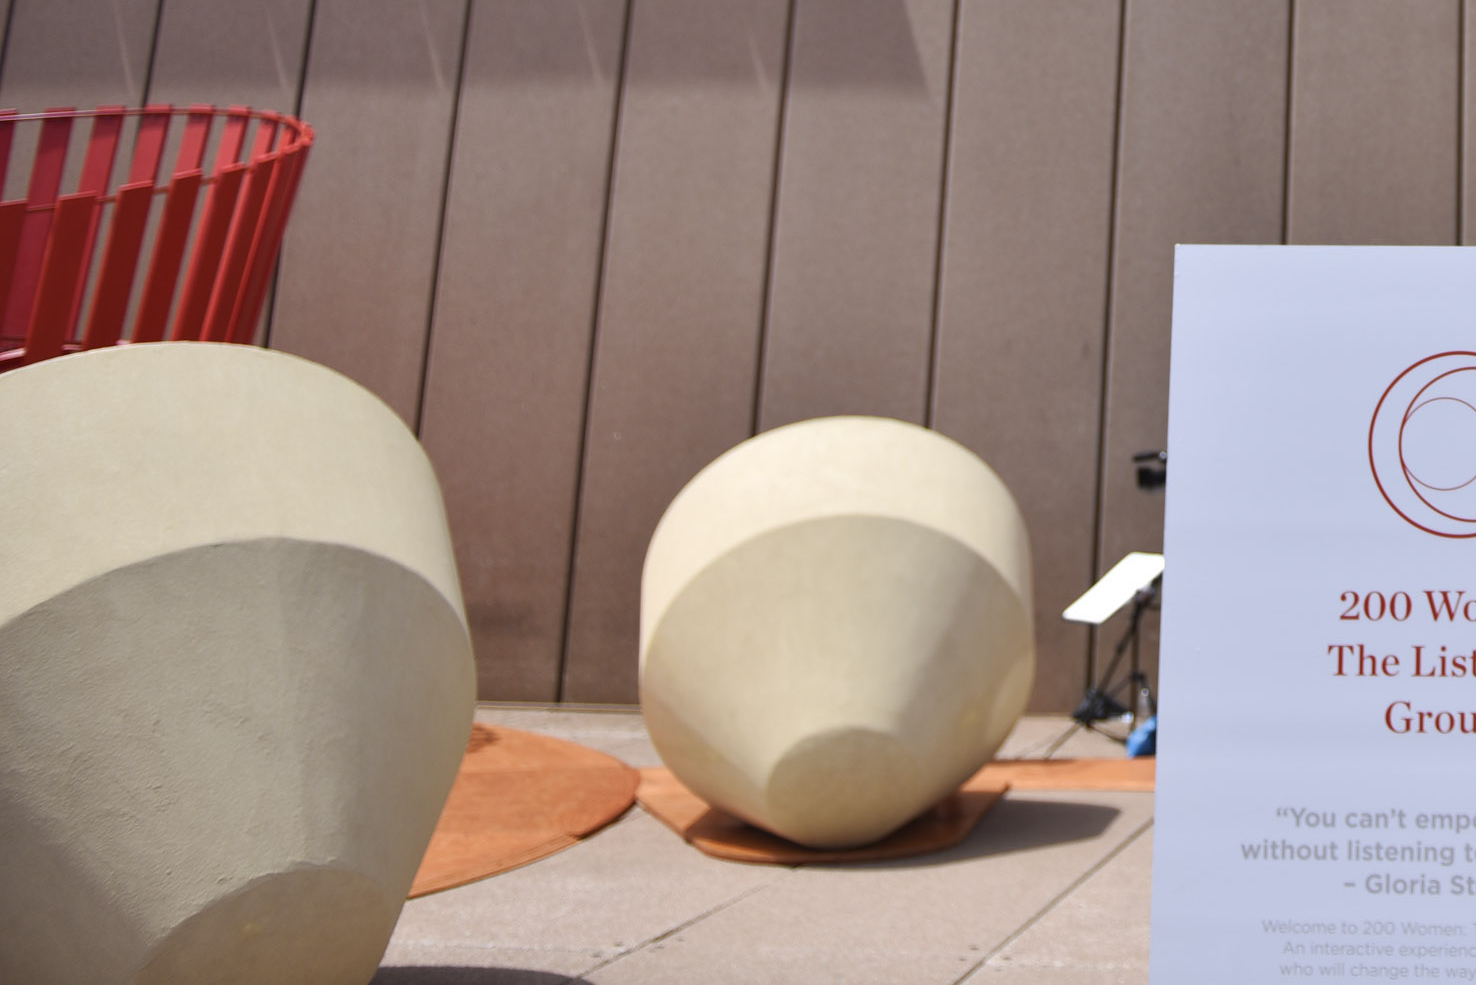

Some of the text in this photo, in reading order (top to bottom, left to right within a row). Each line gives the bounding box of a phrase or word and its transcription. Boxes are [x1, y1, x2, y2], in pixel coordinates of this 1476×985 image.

[1338, 589, 1414, 622] 200
[1326, 643, 1401, 678] The
[1240, 838, 1339, 862] without
[1347, 839, 1456, 867] listening
[1364, 872, 1442, 896] Gloria
[1261, 919, 1337, 935] Welcome
[1340, 921, 1359, 935] to
[1362, 920, 1397, 936] 200
[1282, 940, 1306, 955] An
[1309, 940, 1395, 957] interactive
[1278, 961, 1315, 977] who
[1318, 962, 1346, 977] will
[1349, 962, 1410, 981] change
[1413, 963, 1441, 979] the
